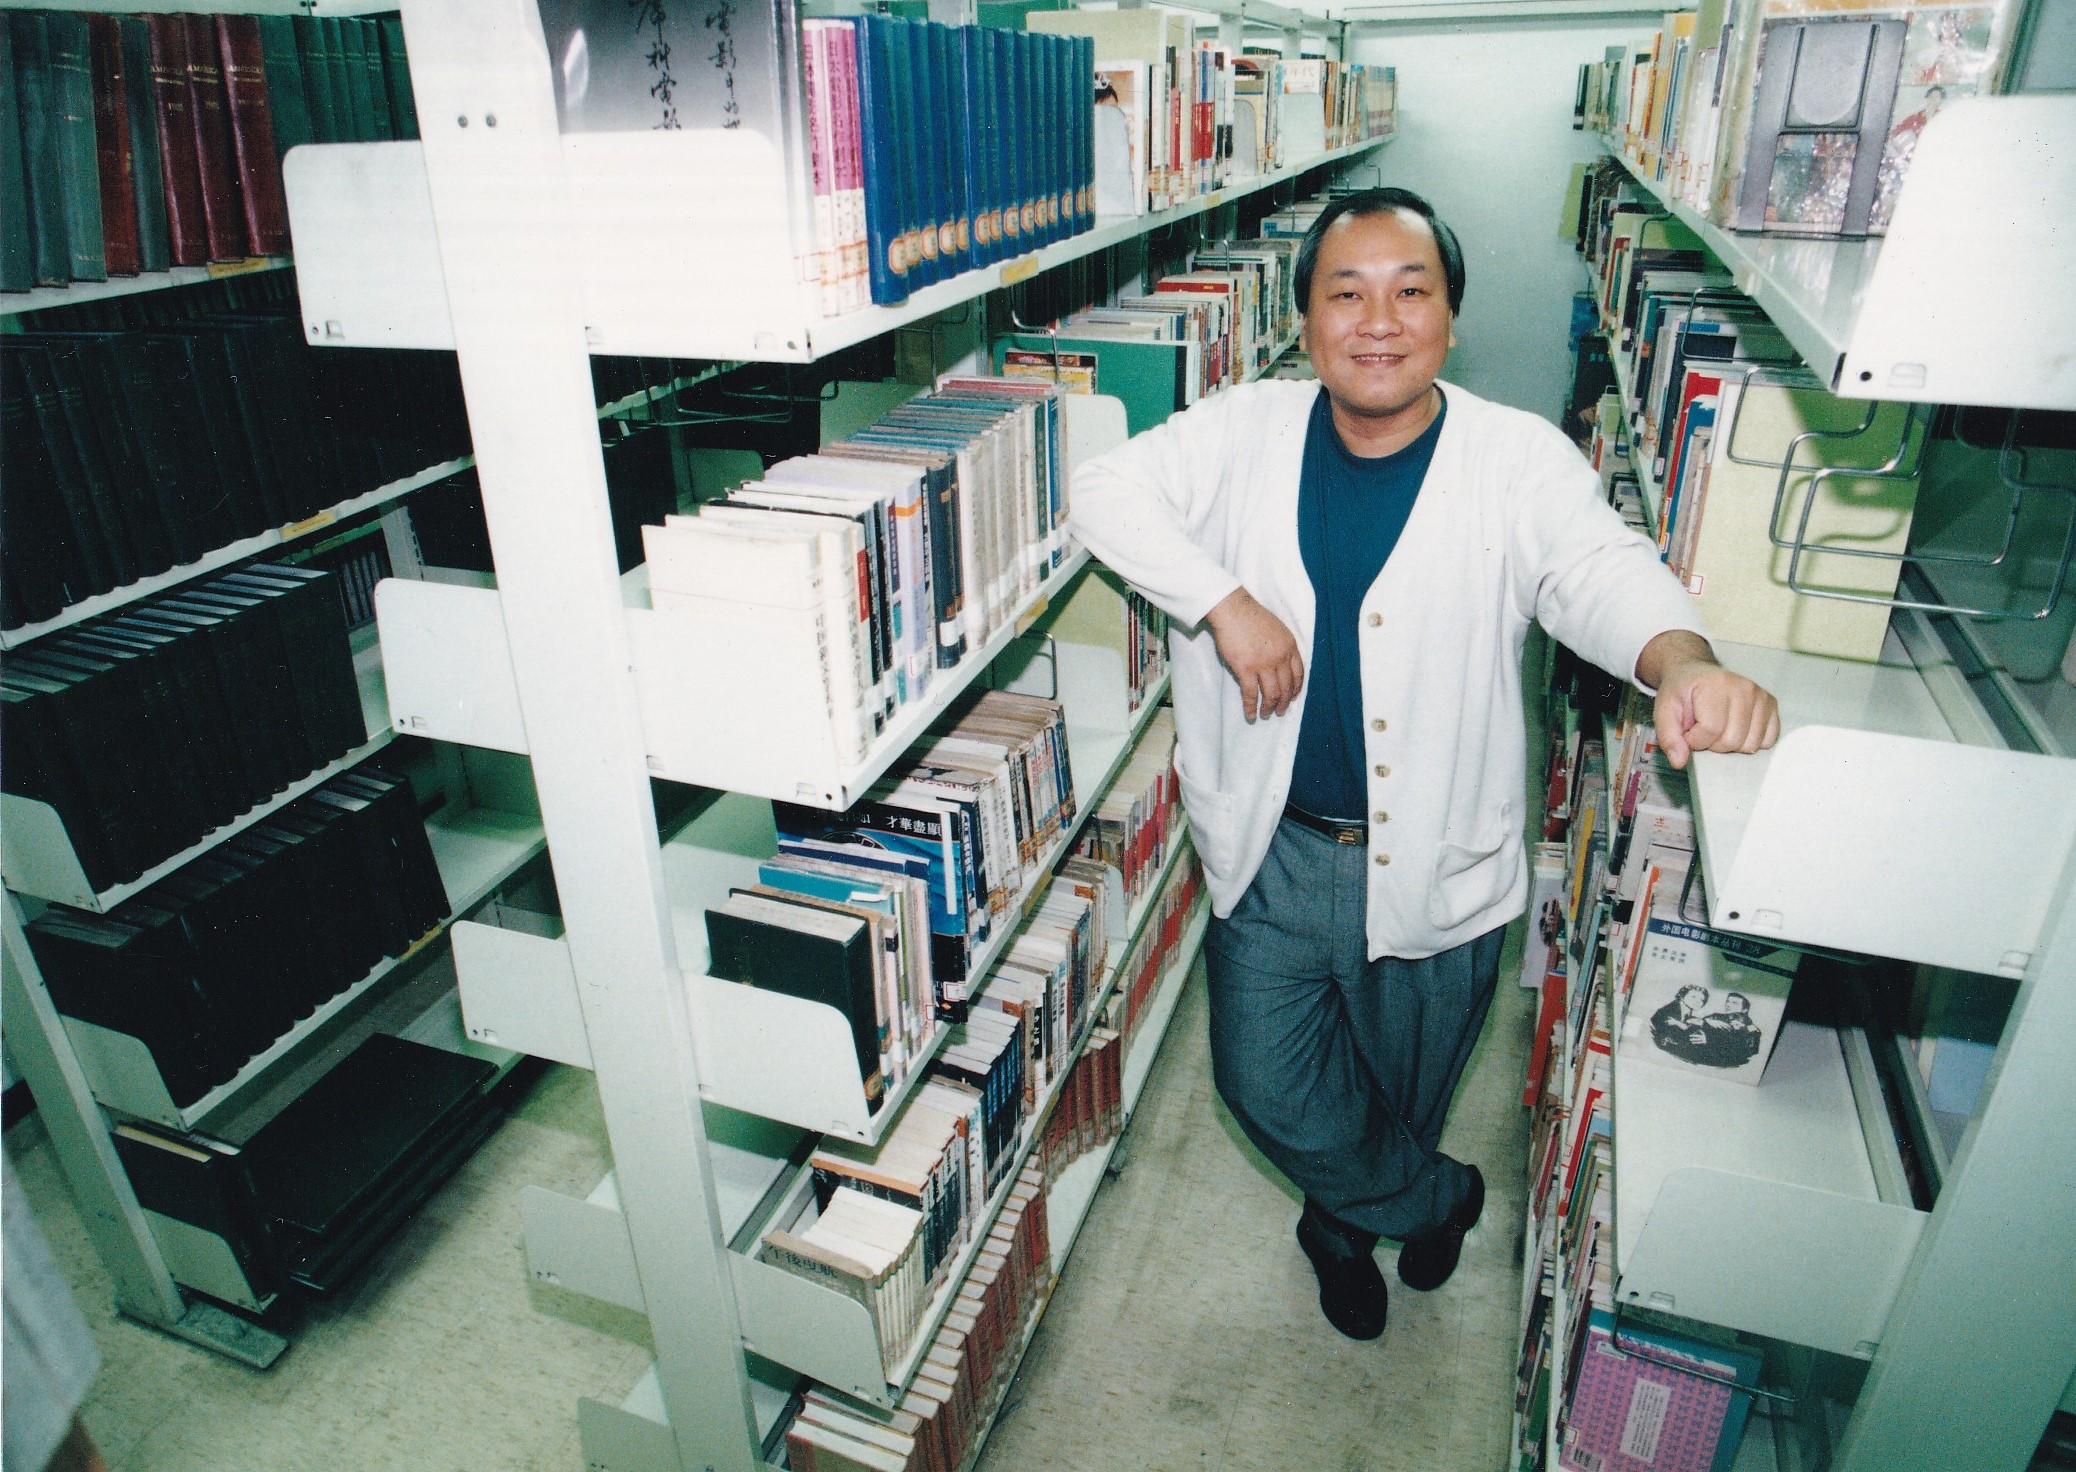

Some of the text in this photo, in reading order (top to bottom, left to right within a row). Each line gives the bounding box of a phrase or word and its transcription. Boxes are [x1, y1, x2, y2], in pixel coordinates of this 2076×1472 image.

[885, 815, 942, 837] 才華盡顯
[1661, 923, 1741, 950] 外国电影剧本丛刊
